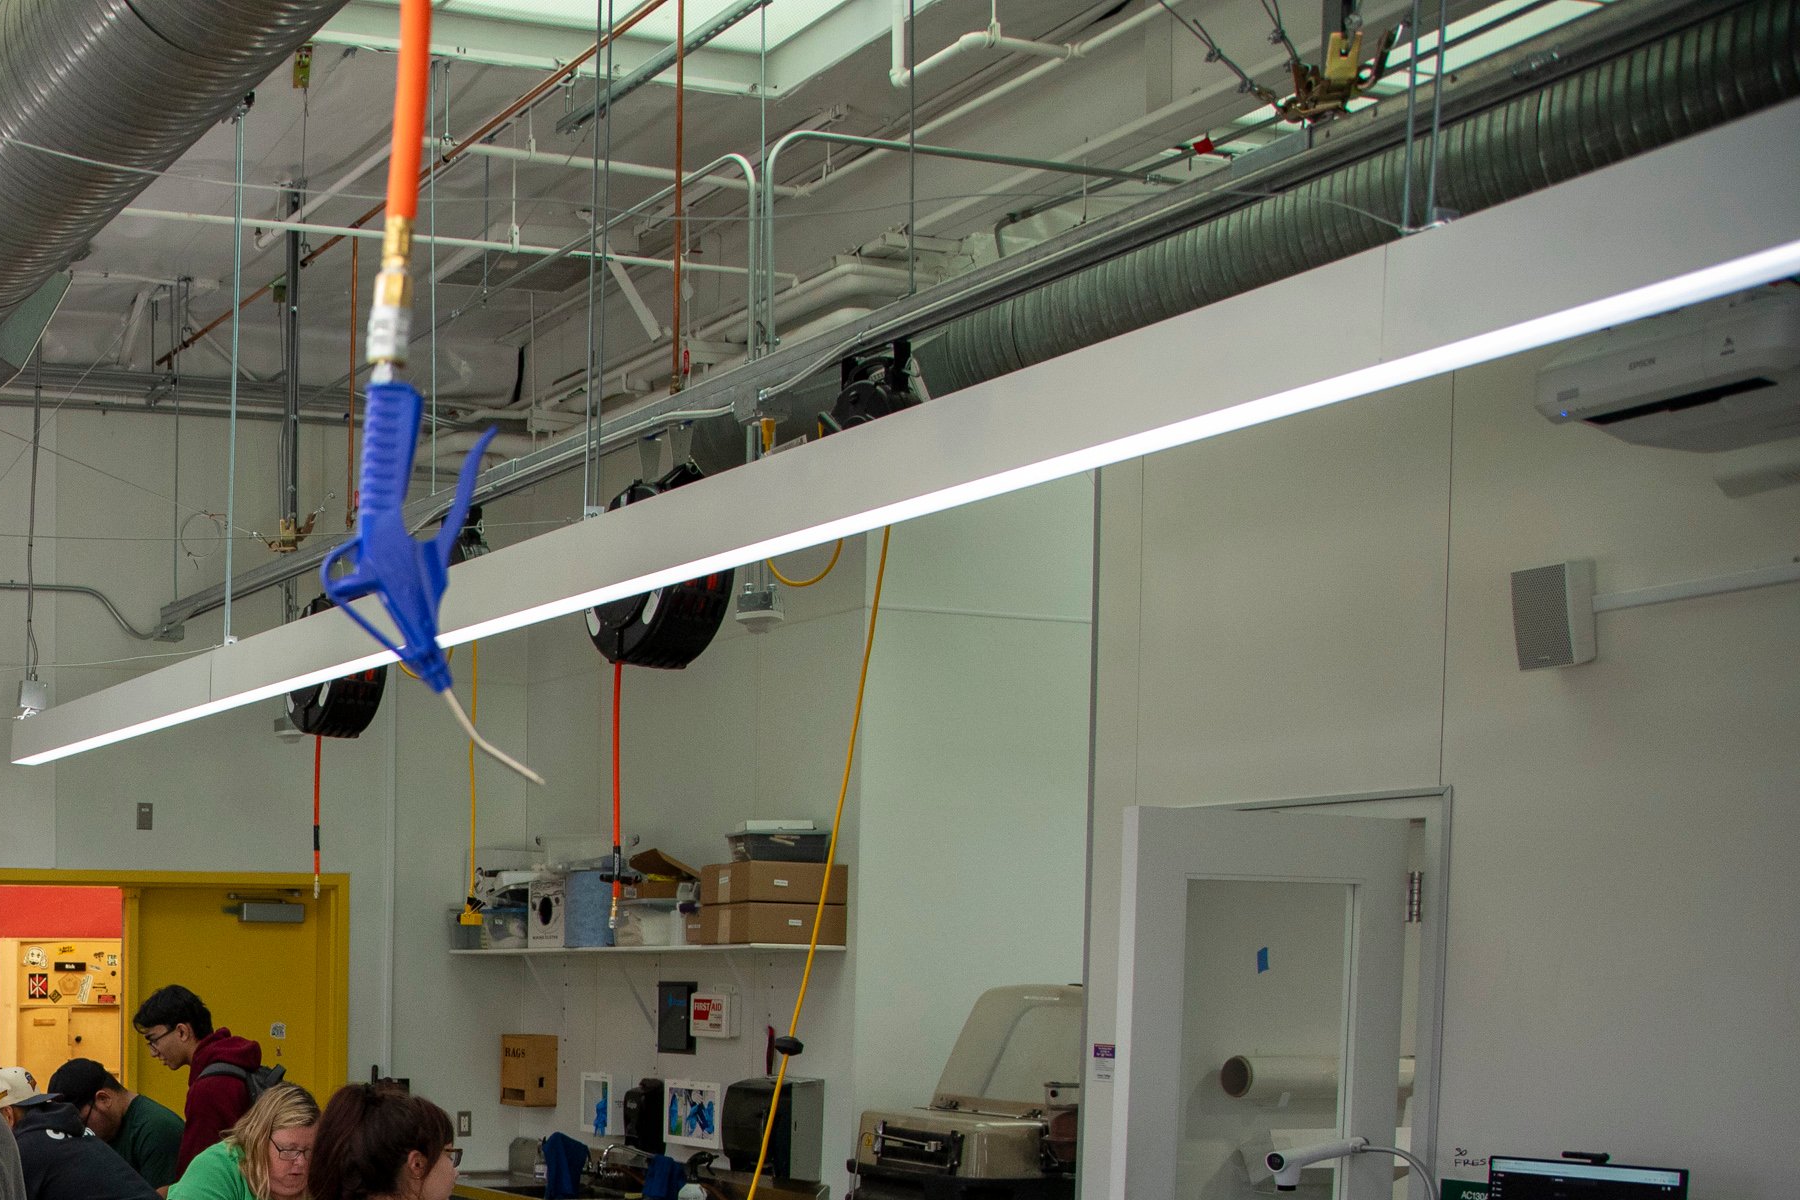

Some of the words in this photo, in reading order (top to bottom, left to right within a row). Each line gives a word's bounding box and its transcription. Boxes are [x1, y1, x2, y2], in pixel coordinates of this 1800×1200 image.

[694, 1001, 711, 1012] FIRST
[711, 1002, 722, 1012] AID
[505, 1047, 526, 1058] RAGS
[1454, 1158, 1487, 1168] FRES
